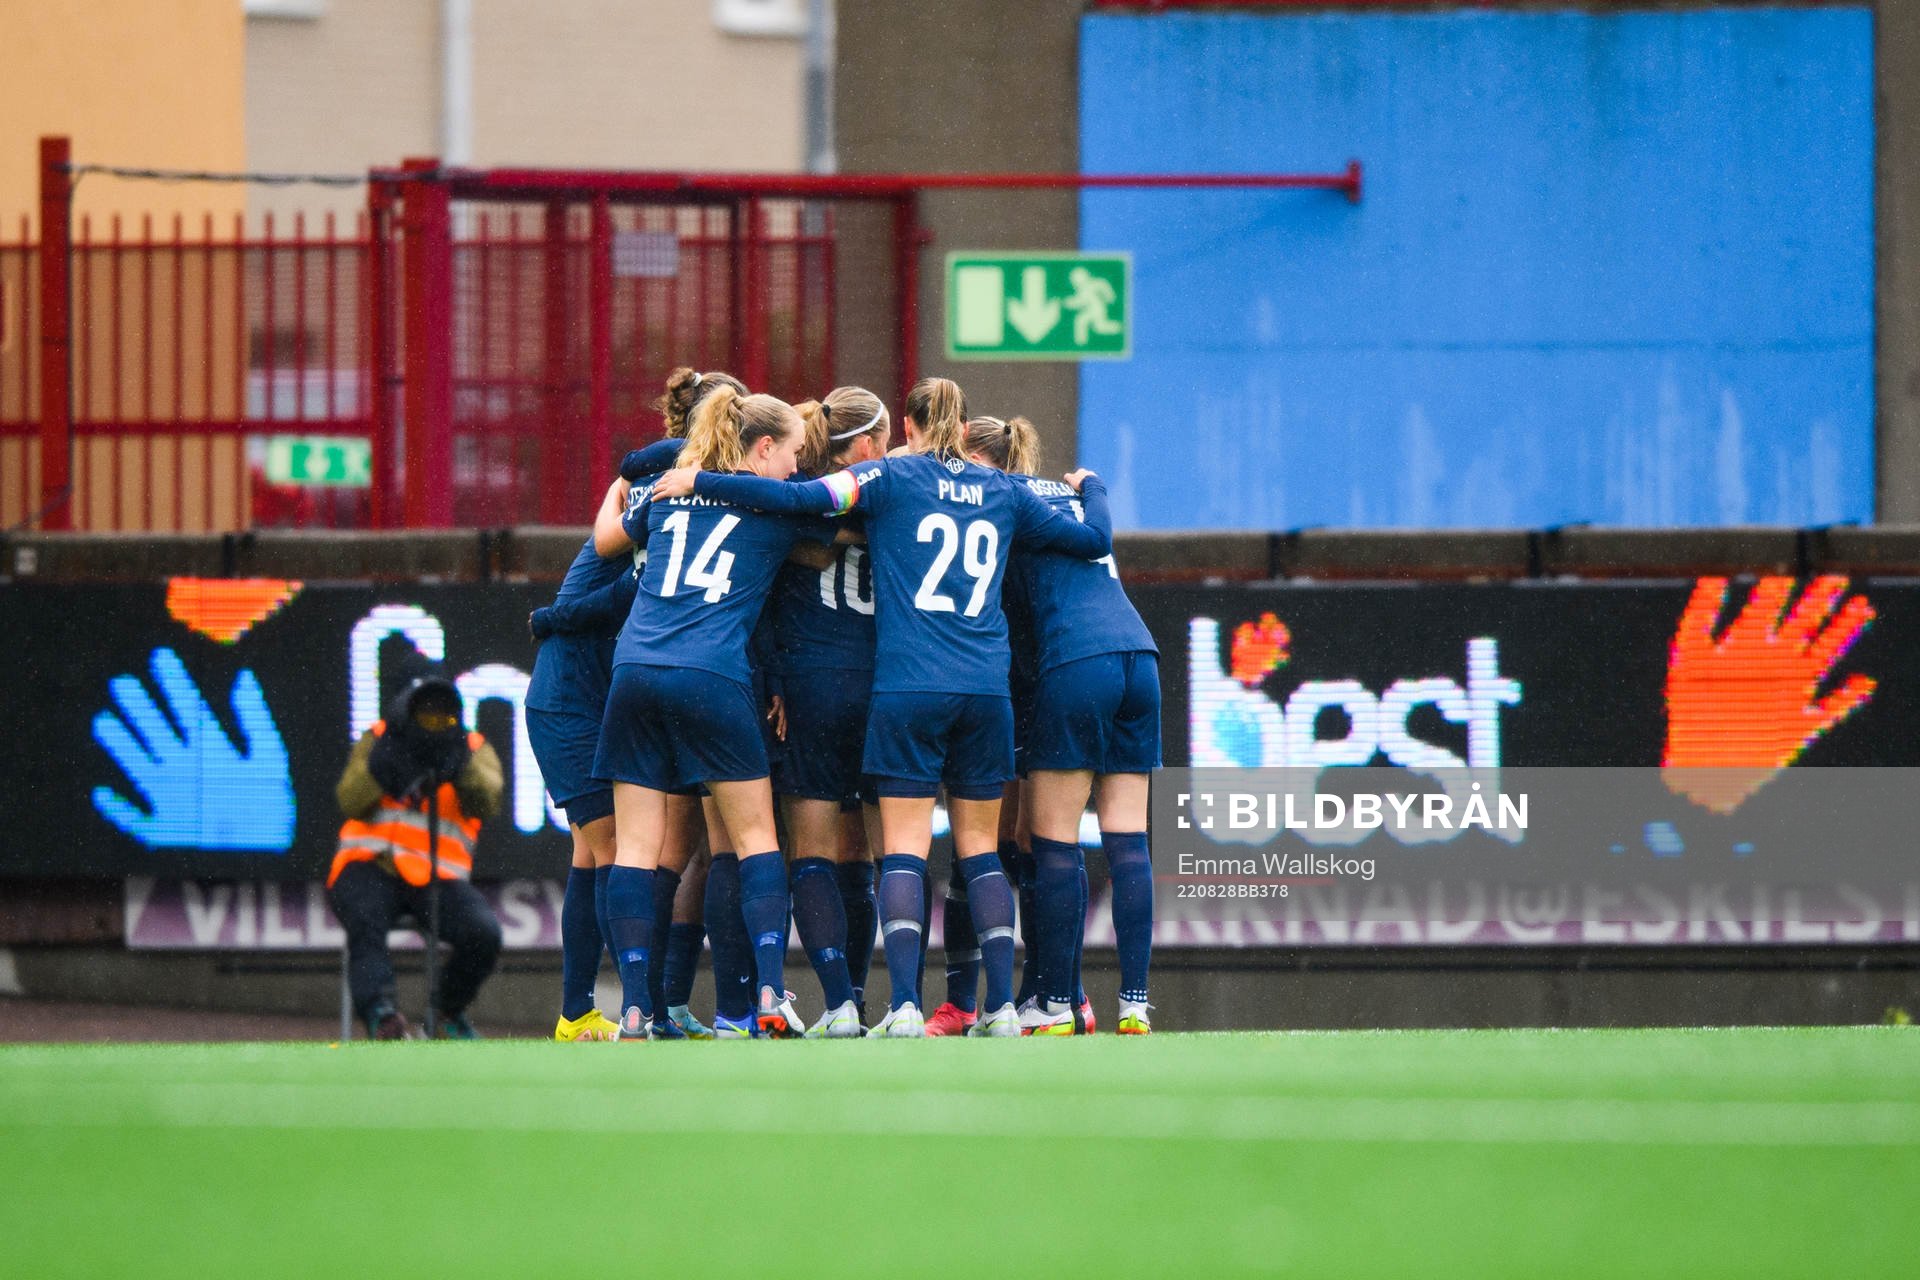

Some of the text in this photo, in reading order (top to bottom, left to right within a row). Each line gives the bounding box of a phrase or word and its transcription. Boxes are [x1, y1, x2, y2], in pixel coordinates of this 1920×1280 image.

[938, 479, 983, 506] PLAN
[660, 511, 741, 603] 14
[915, 513, 998, 617] 29
[1189, 616, 1524, 845] best
